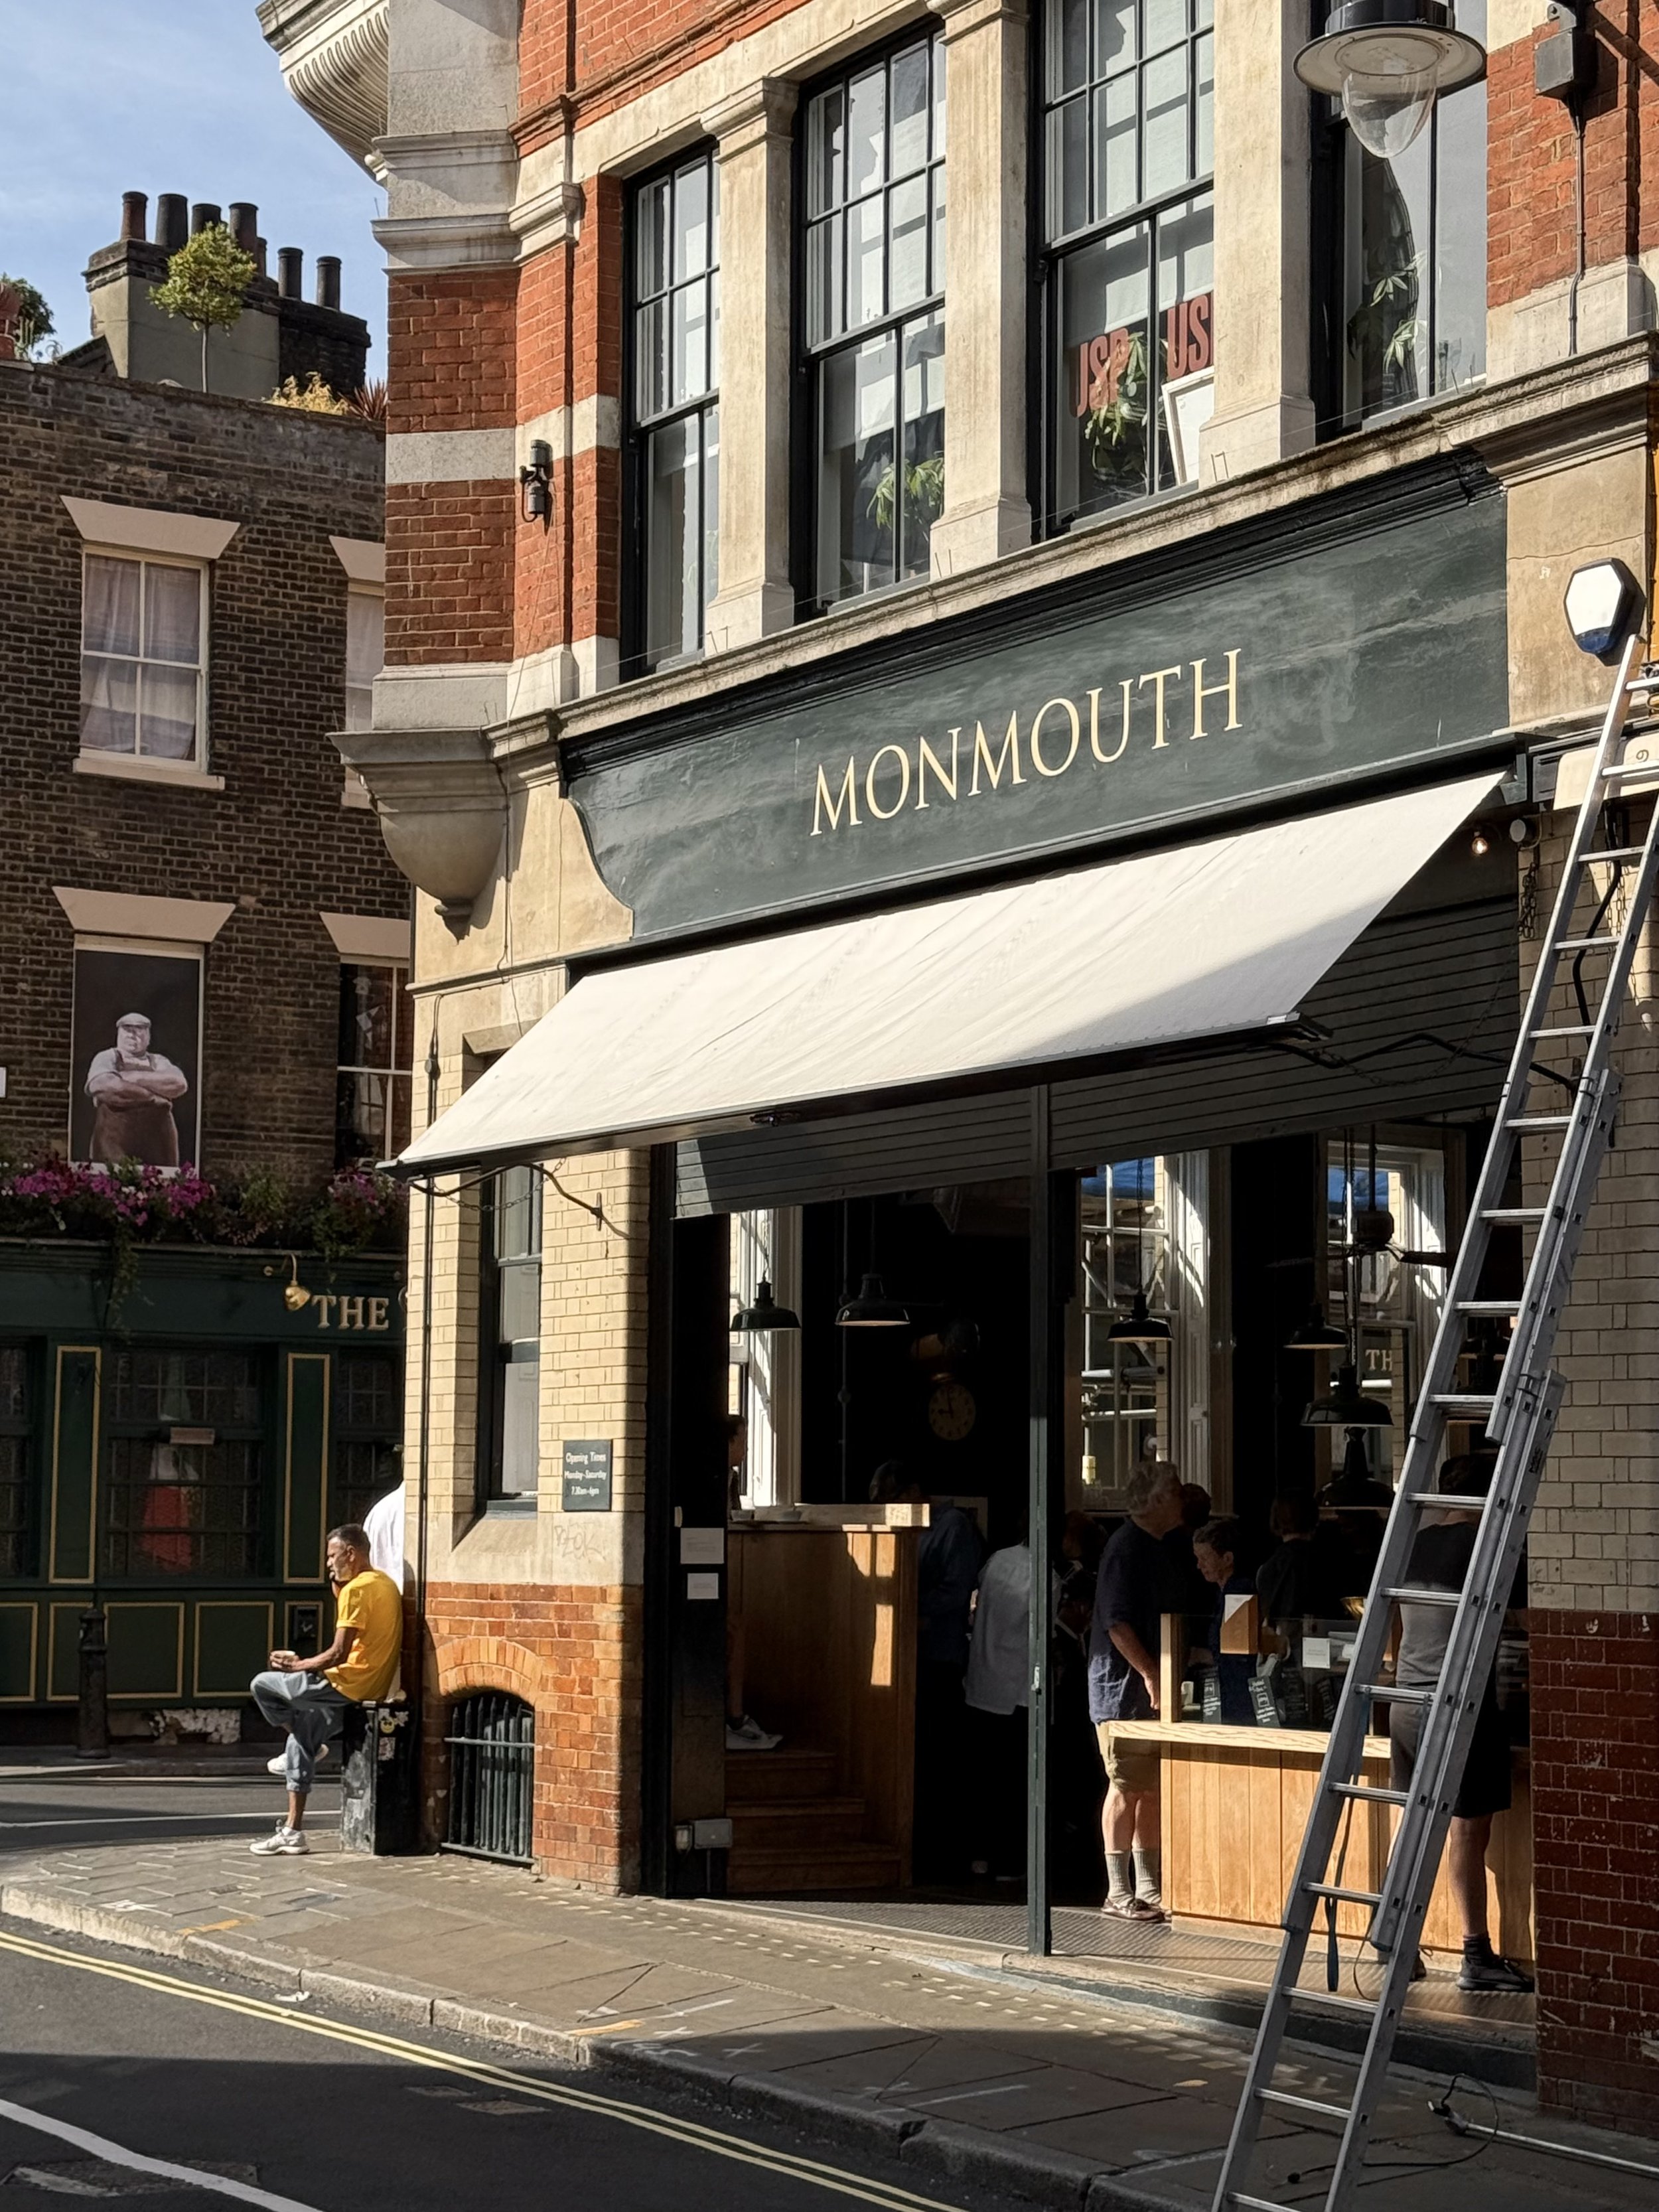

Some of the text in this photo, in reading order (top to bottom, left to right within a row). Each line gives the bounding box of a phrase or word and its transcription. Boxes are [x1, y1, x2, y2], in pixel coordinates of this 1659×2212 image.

[810, 648, 1242, 836] MONMOUTH
[311, 1295, 390, 1331] THE
[1365, 1349, 1393, 1372] TH
